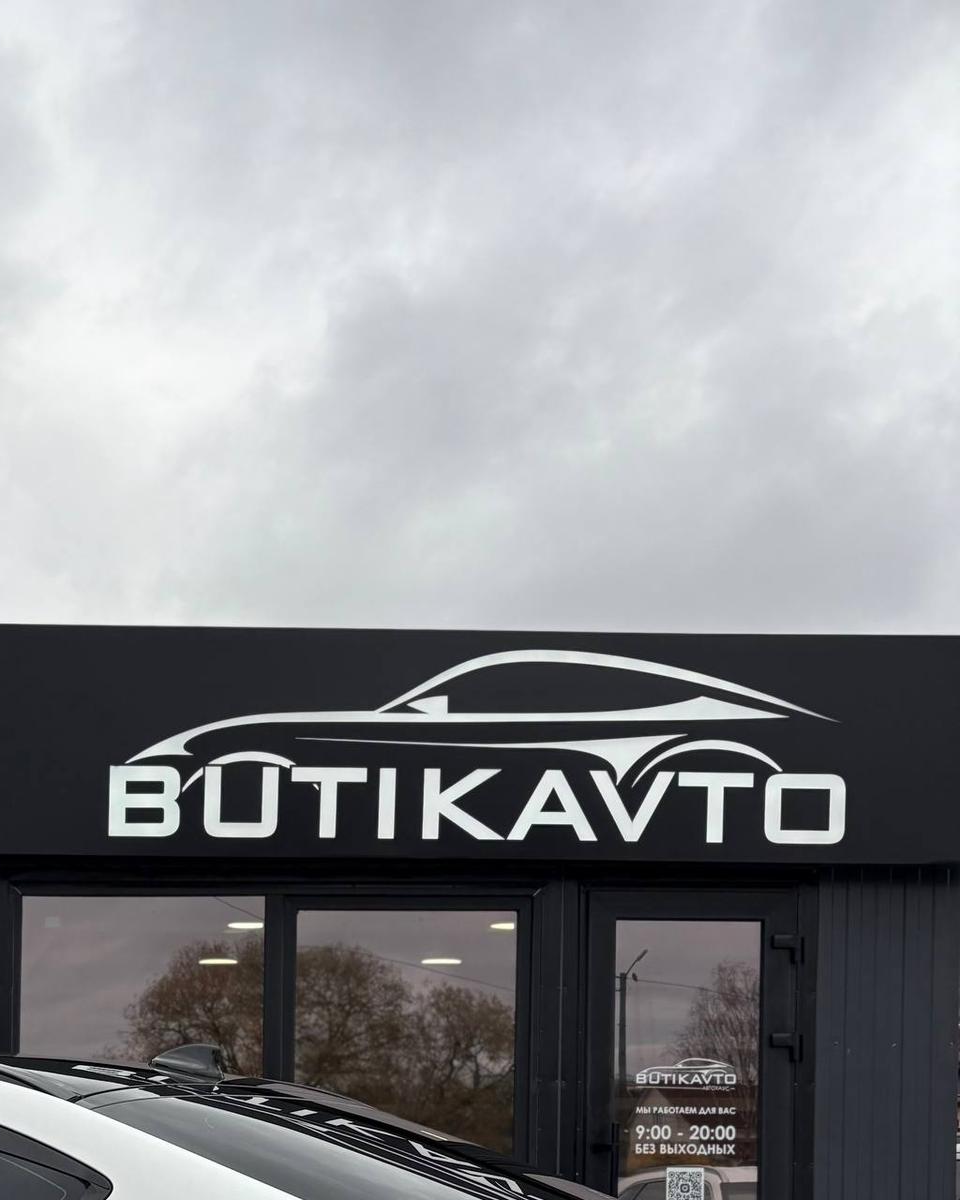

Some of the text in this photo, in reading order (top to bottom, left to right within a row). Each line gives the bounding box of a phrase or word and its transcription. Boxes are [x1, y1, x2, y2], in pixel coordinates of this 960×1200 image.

[108, 763, 847, 845] BUTIKAVTO
[635, 1073, 737, 1085] BUTIKAVTO
[635, 1106, 737, 1115] МЫ РАБОТАЕМ ДЛЯ ВАС
[635, 1124, 672, 1140] 9:00
[689, 1124, 736, 1141] 20:00
[635, 1143, 736, 1156] БЕЗ ВЫХОДНЫХ
